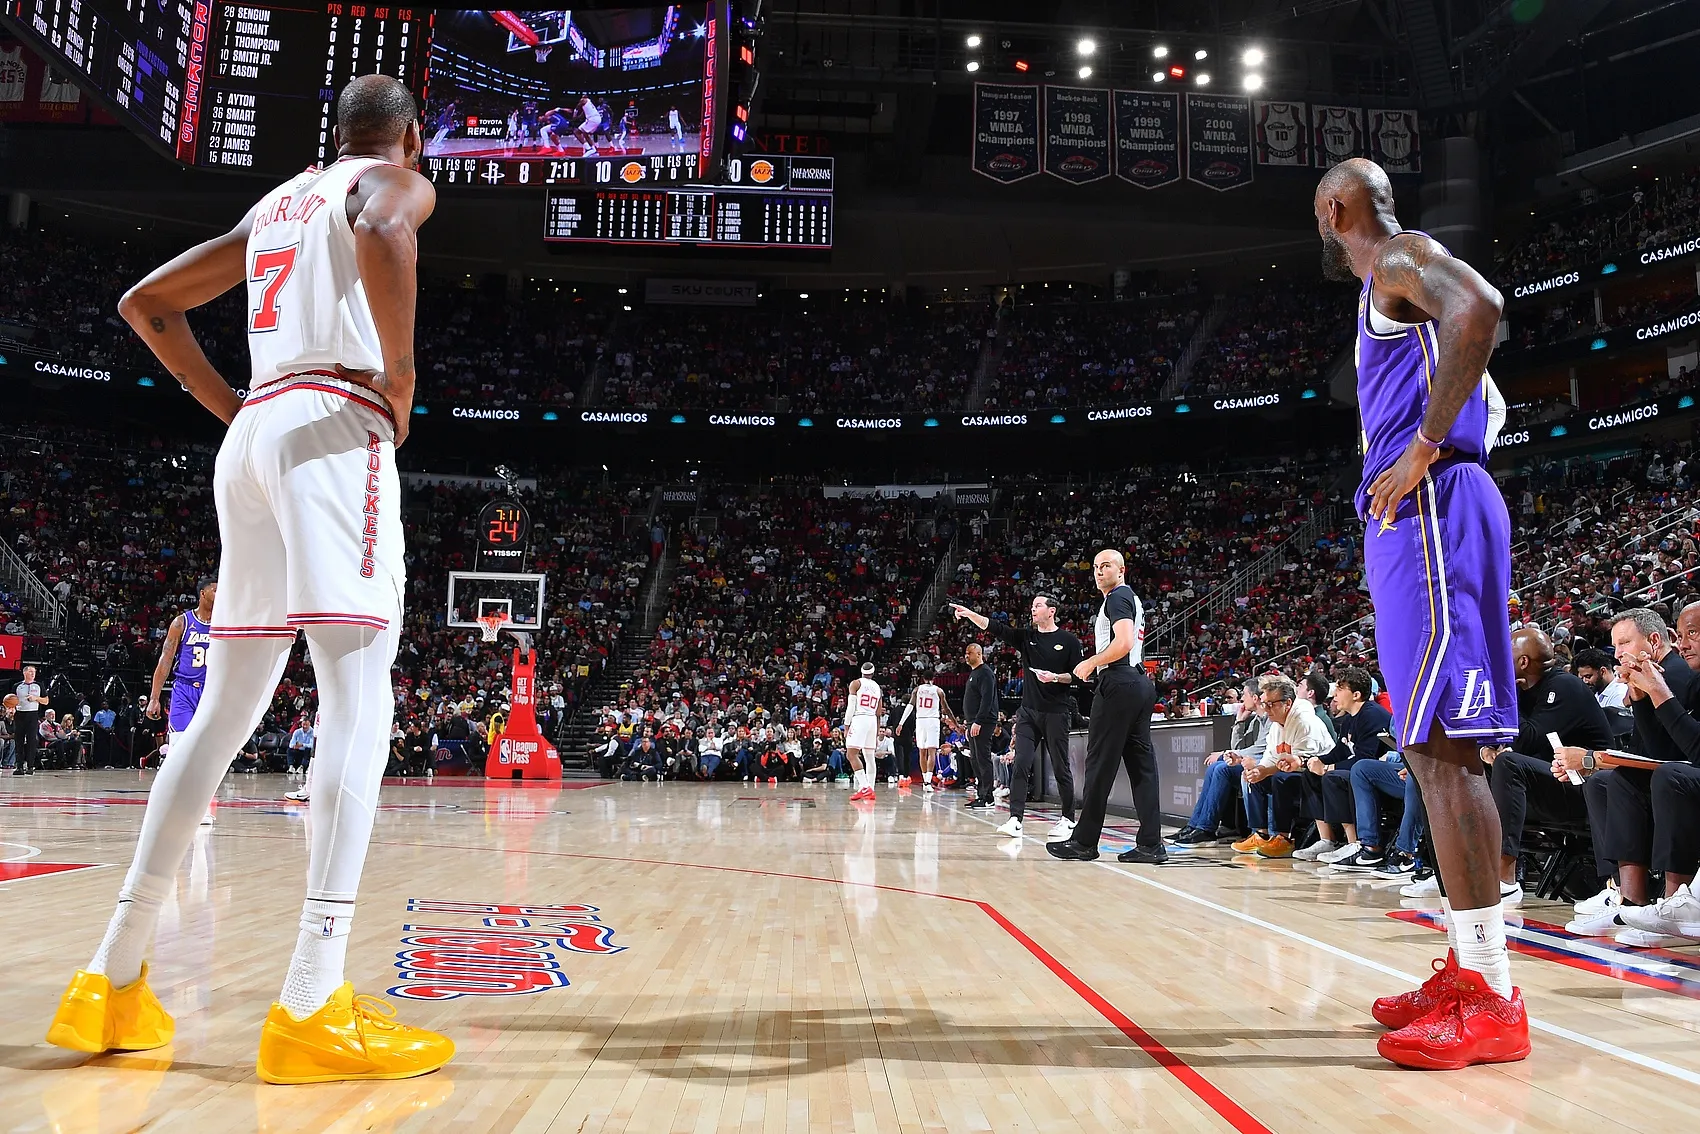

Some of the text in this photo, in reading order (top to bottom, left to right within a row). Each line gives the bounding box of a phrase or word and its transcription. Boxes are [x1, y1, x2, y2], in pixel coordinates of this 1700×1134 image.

[327, 3, 412, 21] PTS REB AST FLS
[92, 15, 97, 30] 2
[224, 6, 408, 34] 28 SENGUN 2 2 1 0
[91, 31, 95, 44] 1
[225, 20, 407, 48] 7 DURANT 0 0 0 0
[224, 35, 405, 62] 1 THOMPSON 4 3 0 1
[86, 61, 91, 75] 4
[220, 49, 229, 60] 10
[232, 50, 259, 64] SMITH
[259, 53, 272, 66] JR.
[327, 60, 333, 71] 0
[352, 61, 356, 72] 1
[399, 65, 405, 76] 2
[182, 1, 208, 143] ROCKETS
[219, 63, 332, 85] 17 EASON 2
[319, 89, 334, 101] PTS
[1057, 94, 1098, 103] Back-to-Back
[216, 92, 329, 114] 5 AYTON 4
[1217, 102, 1248, 110] Champs
[212, 107, 327, 128] 36 SMART 0
[994, 110, 1020, 121] 1997
[1064, 112, 1091, 123] 1998
[1134, 116, 1160, 127] 1999
[989, 122, 1024, 133] WNBA
[1060, 124, 1095, 135] WNBA
[1206, 119, 1233, 129] 2000
[212, 121, 326, 143] 77 DONCIC 0
[467, 127, 502, 136] REPLAY
[1130, 128, 1164, 139] WNBA
[1203, 130, 1236, 141] WNBA
[978, 133, 1035, 146] Champions
[1049, 135, 1106, 148] Champions
[1120, 139, 1175, 152] Champions
[209, 136, 324, 158] 23 JAMES 6
[1192, 142, 1248, 154] Champions
[209, 151, 253, 167] 15 REAVES
[429, 158, 475, 171] TOL FLS CC
[651, 154, 696, 169] TOL FLS CC
[519, 162, 529, 183] 8
[550, 161, 576, 178] 7:11
[595, 161, 611, 183] 10
[654, 167, 692, 181] 7 0 1
[432, 171, 471, 183] 7 3 1
[254, 193, 326, 238] DURANT
[249, 241, 300, 334] 7
[1514, 271, 1579, 298] CASAMIGOS
[34, 361, 114, 382] CASAMIGOS
[1213, 393, 1280, 410] CASAMIGOS
[453, 407, 519, 420] CASAMIGOS
[581, 411, 648, 423] CASAMIGOS
[709, 415, 775, 426] CASAMIGOS
[961, 414, 1028, 425] CASAMIGOS
[1087, 406, 1152, 421] CASAMIGOS
[1589, 404, 1658, 430] CASAMIGOS
[836, 418, 901, 429] CASAMIGOS
[360, 430, 382, 578] ROCKETS
[496, 510, 520, 521] 7:11
[489, 521, 517, 542] 24
[517, 677, 527, 686] GET
[517, 686, 527, 695] THE
[1450, 668, 1493, 720] LA
[860, 694, 878, 709] 20
[919, 697, 933, 709] 10
[512, 740, 538, 755] League
[511, 752, 530, 764] Pass
